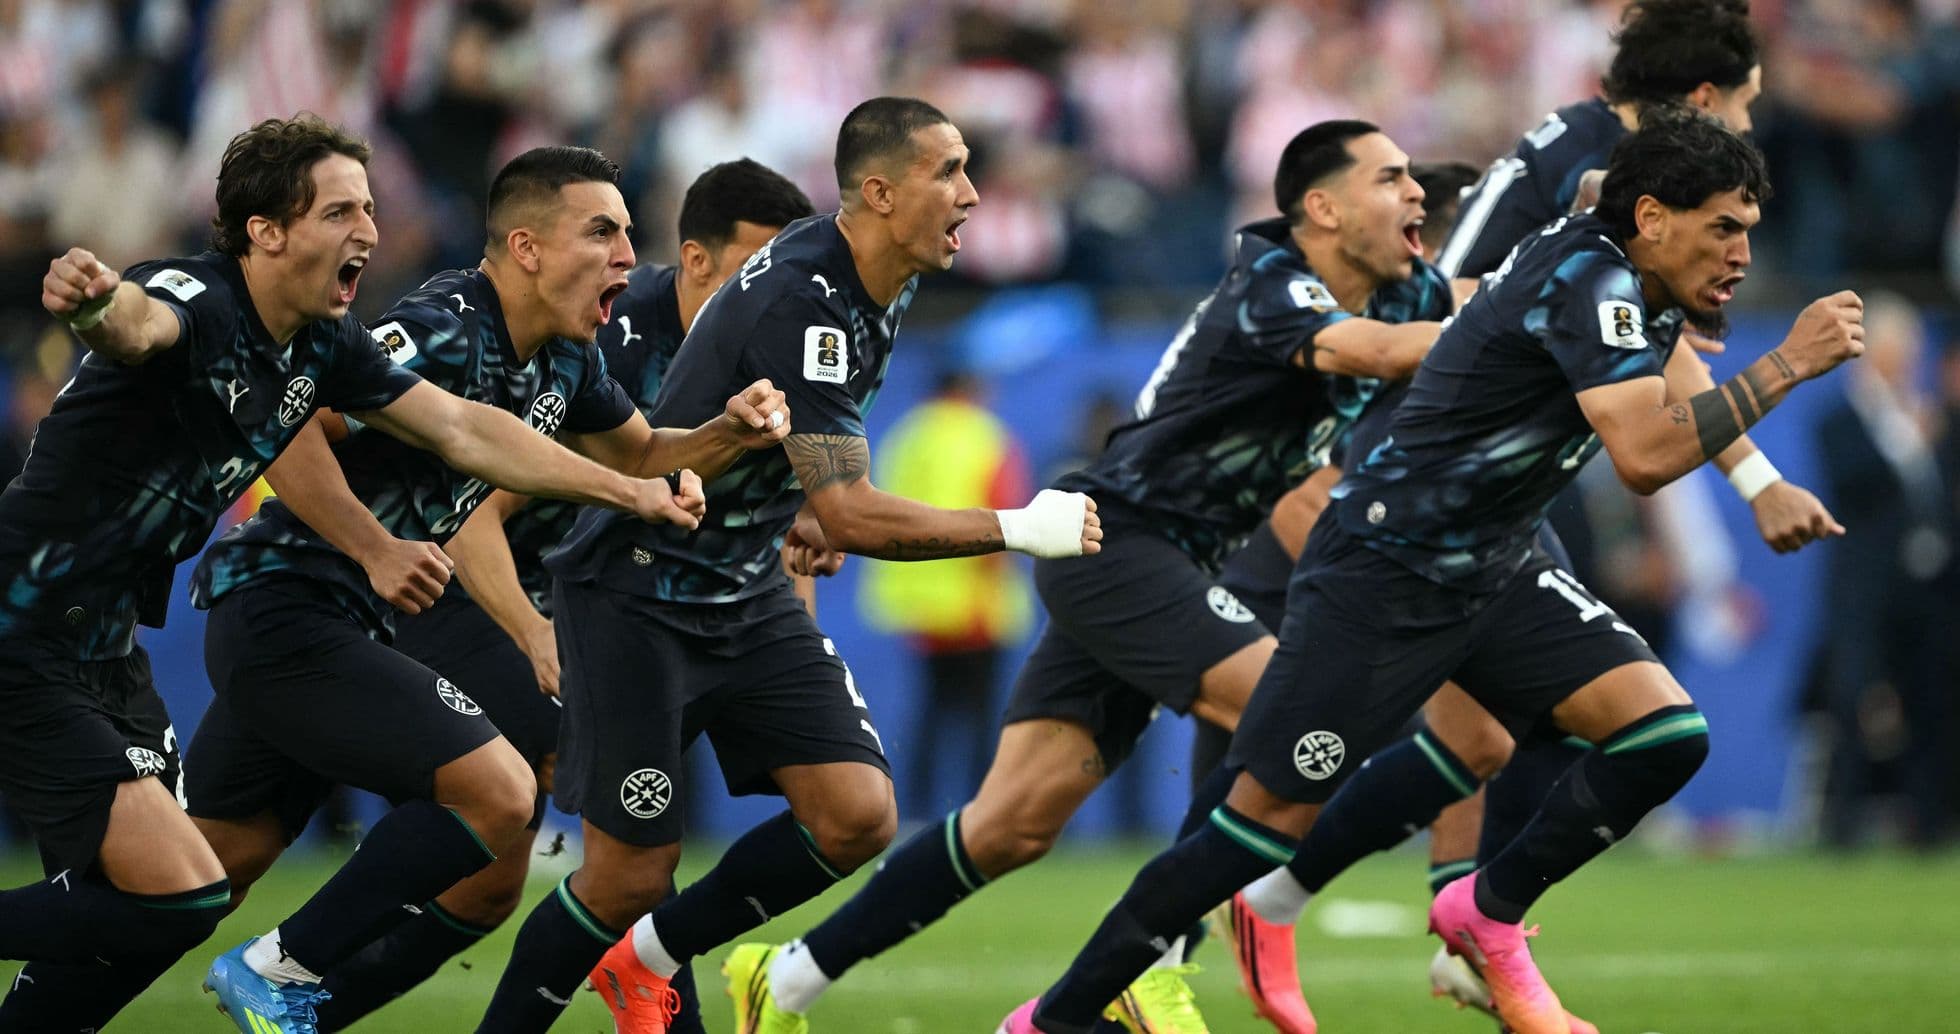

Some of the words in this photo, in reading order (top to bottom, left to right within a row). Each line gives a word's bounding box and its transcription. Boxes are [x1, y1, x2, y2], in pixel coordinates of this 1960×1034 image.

[816, 370, 838, 378] 2026
[542, 396, 556, 407] APF
[639, 772, 657, 782] APF
